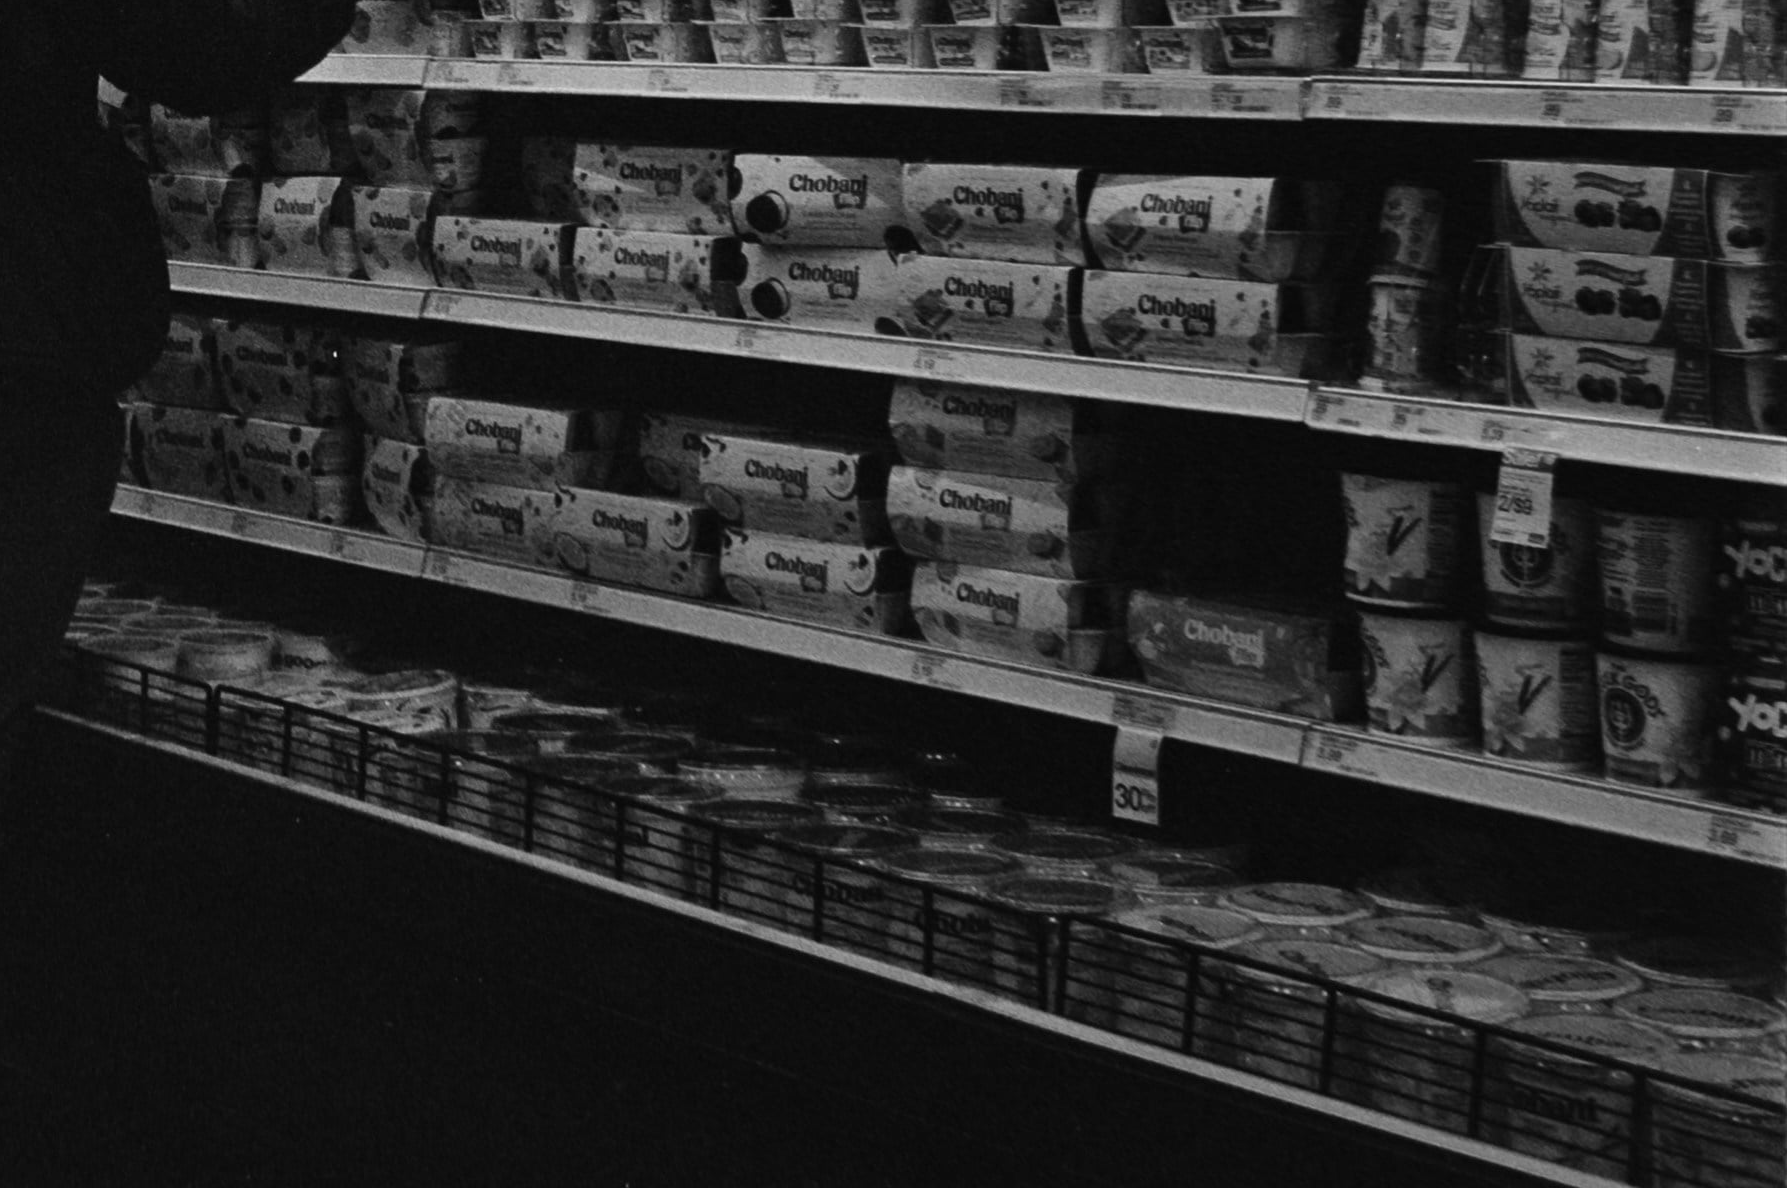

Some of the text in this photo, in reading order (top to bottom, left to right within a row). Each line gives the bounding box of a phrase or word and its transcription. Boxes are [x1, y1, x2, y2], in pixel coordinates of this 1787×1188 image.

[619, 162, 683, 185] Chobani
[788, 172, 869, 196] Chobani
[953, 186, 1024, 208] Chobani
[1140, 193, 1213, 216] Chobani
[614, 247, 671, 270] Chobani
[788, 261, 861, 286] Chobani
[944, 276, 1014, 301] Chobani
[1137, 294, 1216, 320] Chobani
[943, 394, 1019, 422] Chobani
[465, 418, 523, 441] Chobani
[745, 458, 809, 485] Chobani
[939, 489, 1013, 515] Chobani
[592, 510, 649, 535] Chobani
[764, 550, 829, 582] Chobani
[956, 581, 1020, 613] Chobani
[1184, 618, 1265, 651] Chobani
[1114, 782, 1142, 811] 30
